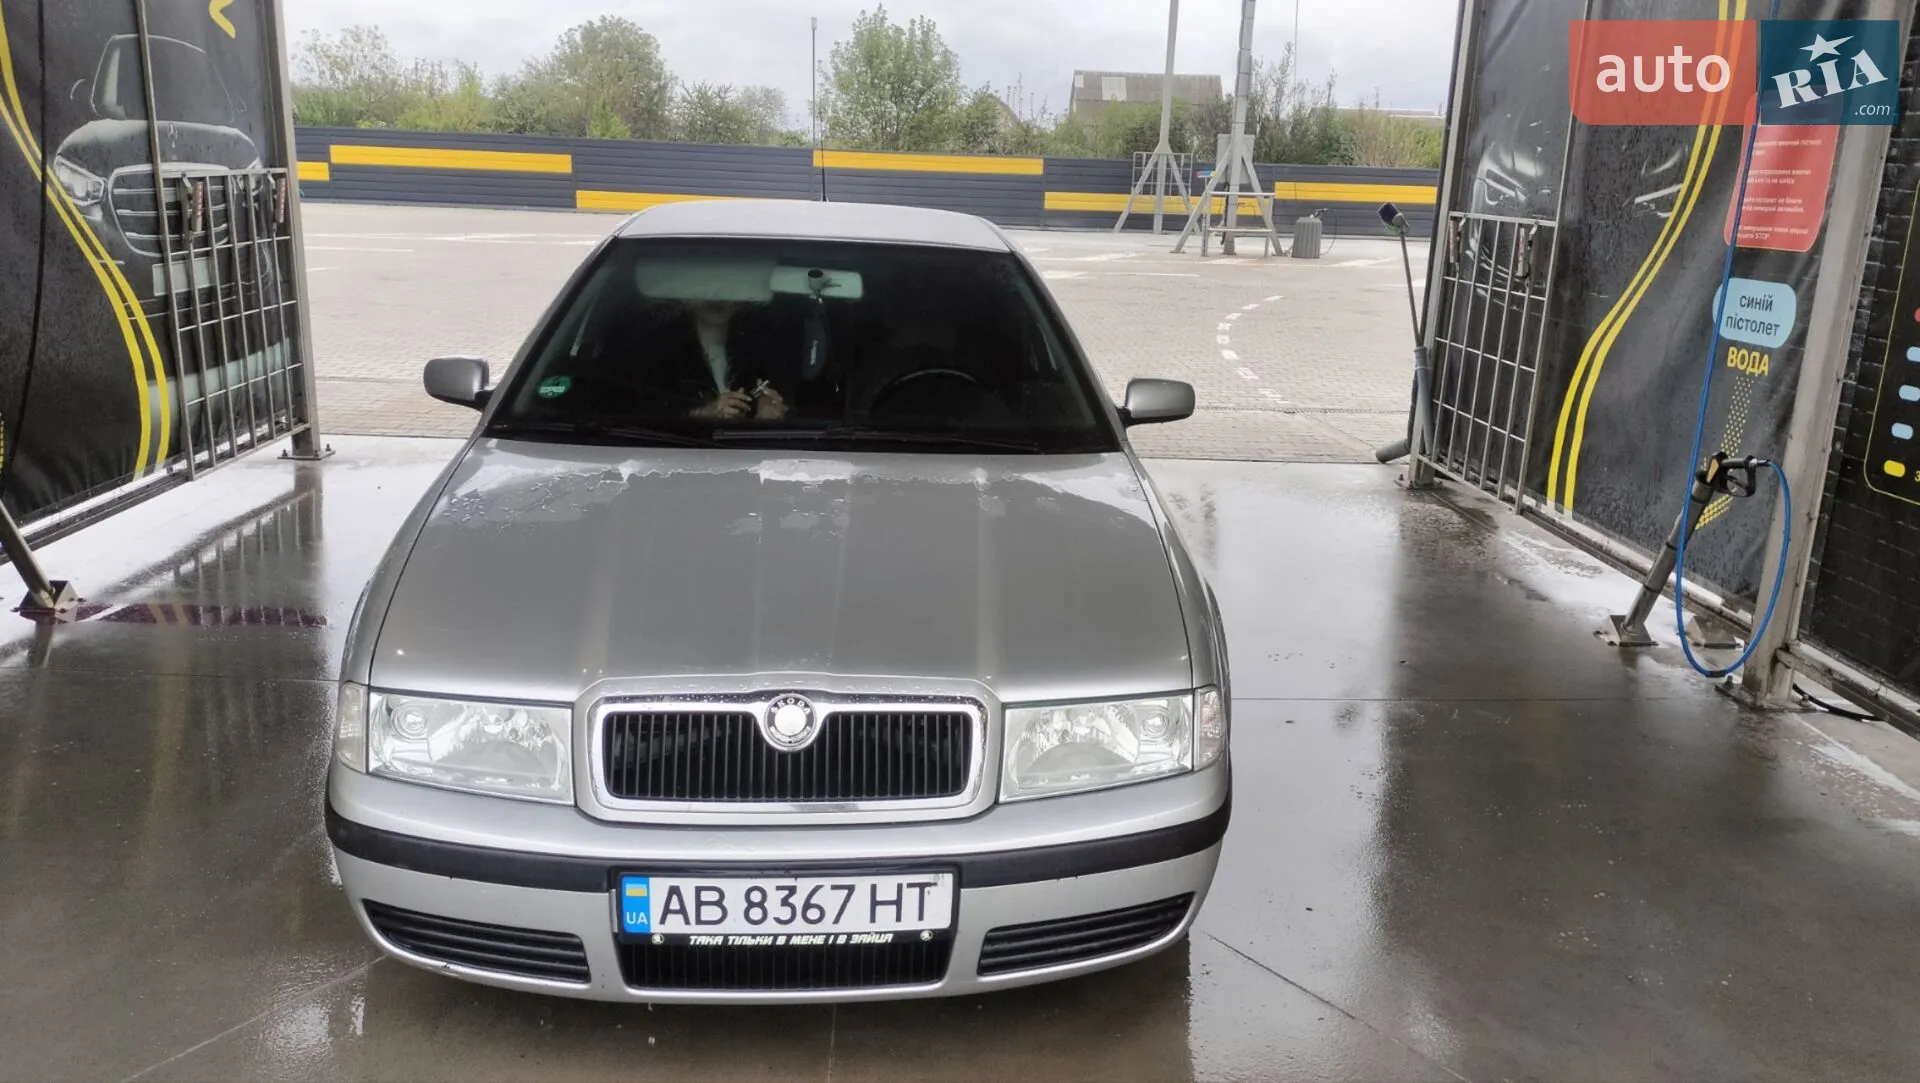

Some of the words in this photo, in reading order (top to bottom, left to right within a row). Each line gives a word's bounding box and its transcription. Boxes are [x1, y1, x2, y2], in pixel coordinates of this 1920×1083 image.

[1739, 294, 1774, 312] синій
[1725, 314, 1780, 337] пістолет
[1726, 346, 1771, 377] ВОДА
[658, 884, 729, 926] AB
[743, 884, 856, 926] 8367
[869, 881, 938, 924] HT
[626, 911, 648, 925] UA
[689, 935, 723, 946] ТАКА
[727, 935, 774, 946] ТІЛЬКИ
[775, 935, 786, 945] В
[789, 934, 826, 945] МЕНЕ
[836, 934, 847, 944] В
